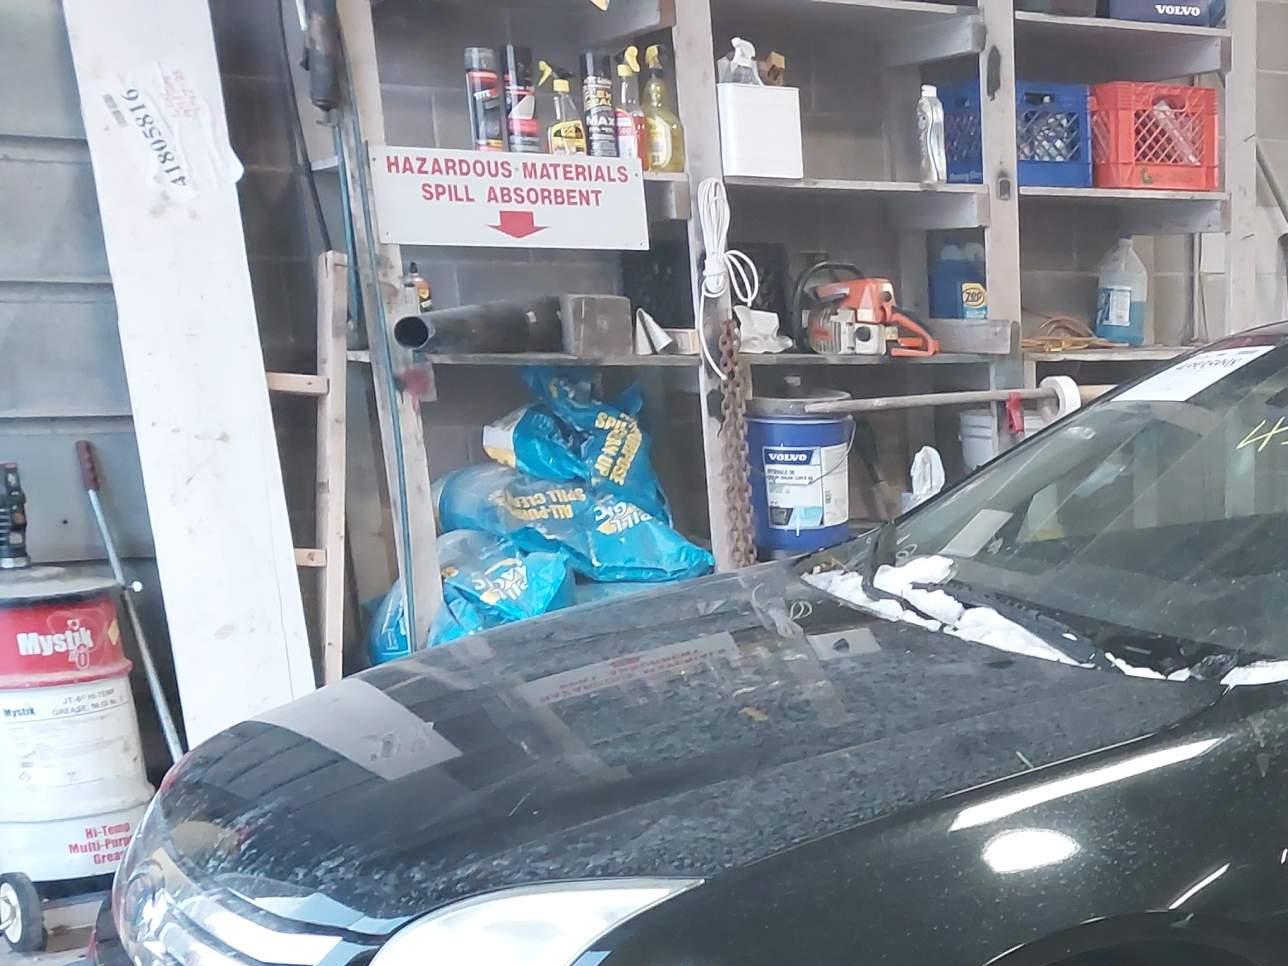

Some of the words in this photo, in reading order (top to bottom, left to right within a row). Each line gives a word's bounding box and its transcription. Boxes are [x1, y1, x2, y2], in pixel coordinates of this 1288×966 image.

[1154, 4, 1201, 17] VOLVO
[121, 88, 187, 186] 41805816
[385, 155, 513, 178] HAZARDOUS
[522, 162, 629, 183] MATERIALS
[421, 183, 475, 203] SPILL
[487, 186, 602, 207] ABSORBENT
[767, 453, 808, 462] VOLVO
[16, 627, 94, 656] Mystik
